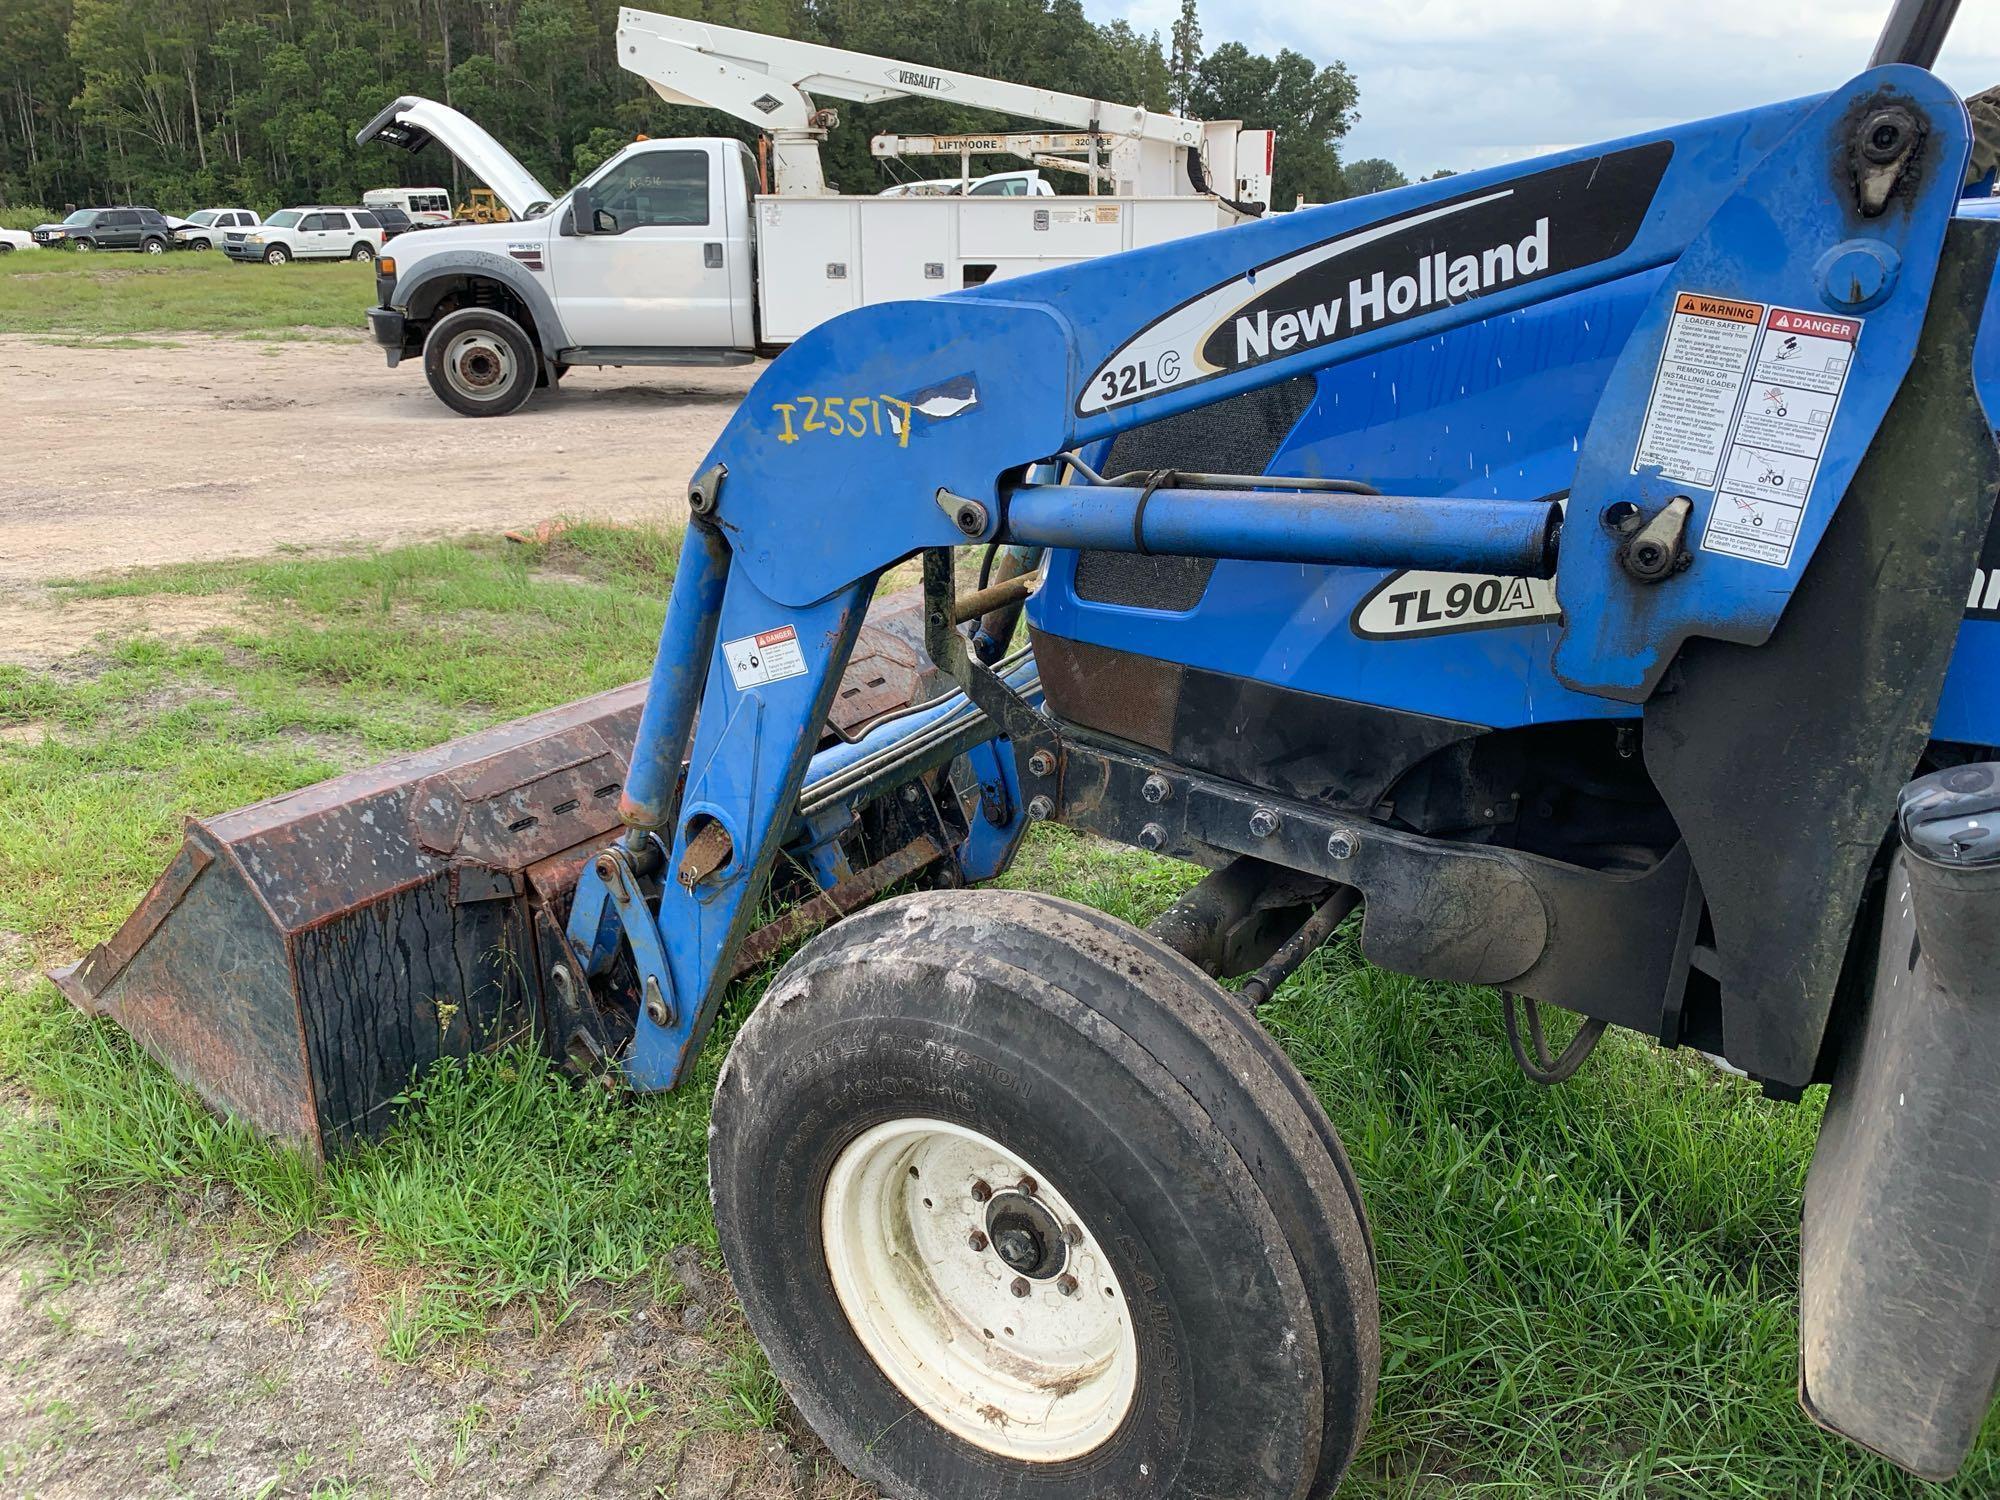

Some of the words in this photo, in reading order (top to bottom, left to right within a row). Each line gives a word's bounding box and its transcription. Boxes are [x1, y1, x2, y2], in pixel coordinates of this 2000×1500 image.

[899, 70, 942, 91] VERSALIFT
[938, 140, 997, 150] LIFTMOORE
[1236, 297, 1343, 364] New
[1349, 217, 1549, 329] Holland
[1699, 302, 1754, 318] WARNING
[1684, 316, 1715, 326] LOADER
[1716, 321, 1745, 331] SAFETY
[1792, 317, 1851, 335] DANGER
[1101, 350, 1180, 401] 32LC
[1676, 365, 1715, 376] REMOVING
[1663, 371, 1704, 383] INSTALLING
[1706, 378, 1736, 389] LOADER
[1709, 533, 1728, 541] Failure
[1736, 539, 1756, 547] comply
[1389, 576, 1534, 626] TL90A
[765, 629, 792, 642] DANGER
